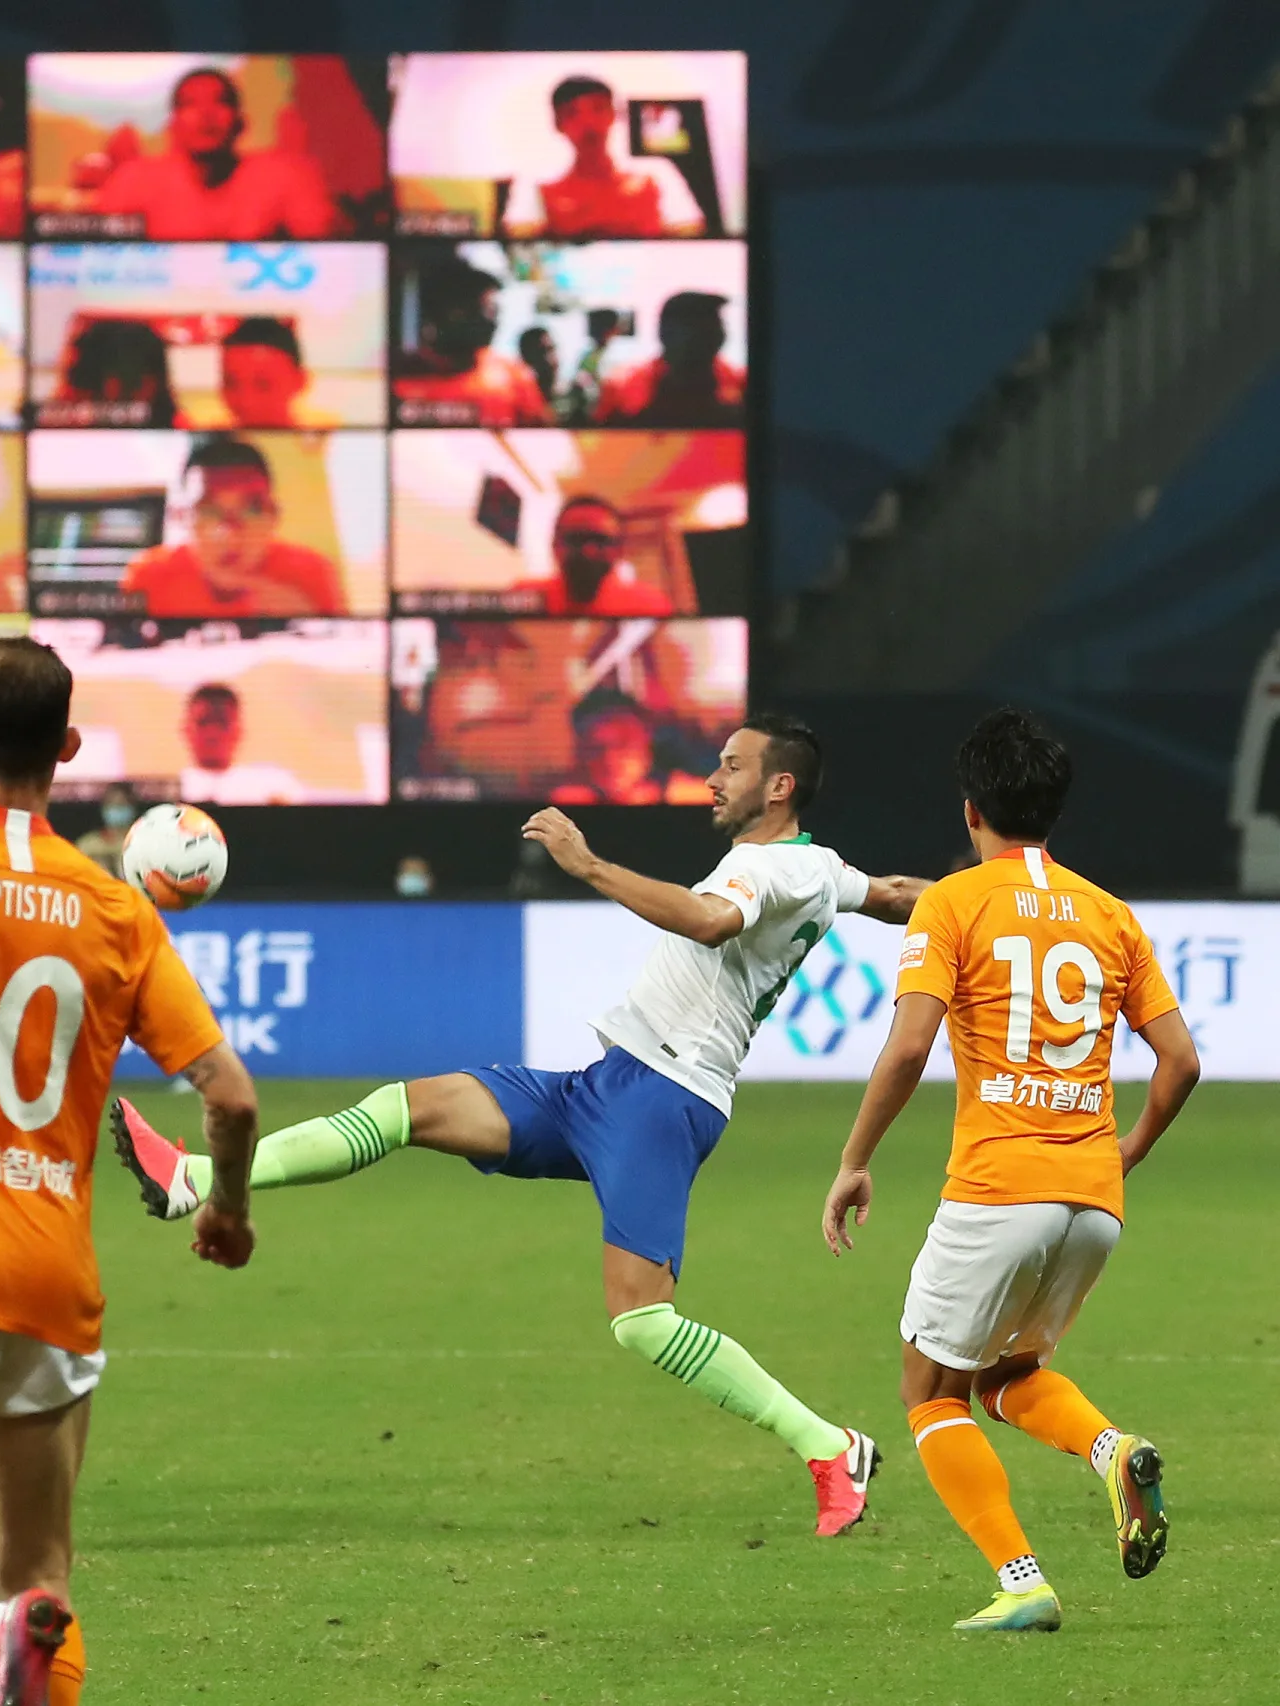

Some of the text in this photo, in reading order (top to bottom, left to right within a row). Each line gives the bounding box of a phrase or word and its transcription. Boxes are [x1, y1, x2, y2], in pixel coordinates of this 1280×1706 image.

[1015, 892, 1081, 923] HU J.H.
[993, 936, 1104, 1070] 19
[980, 1073, 1103, 1116] 卓尔智城
